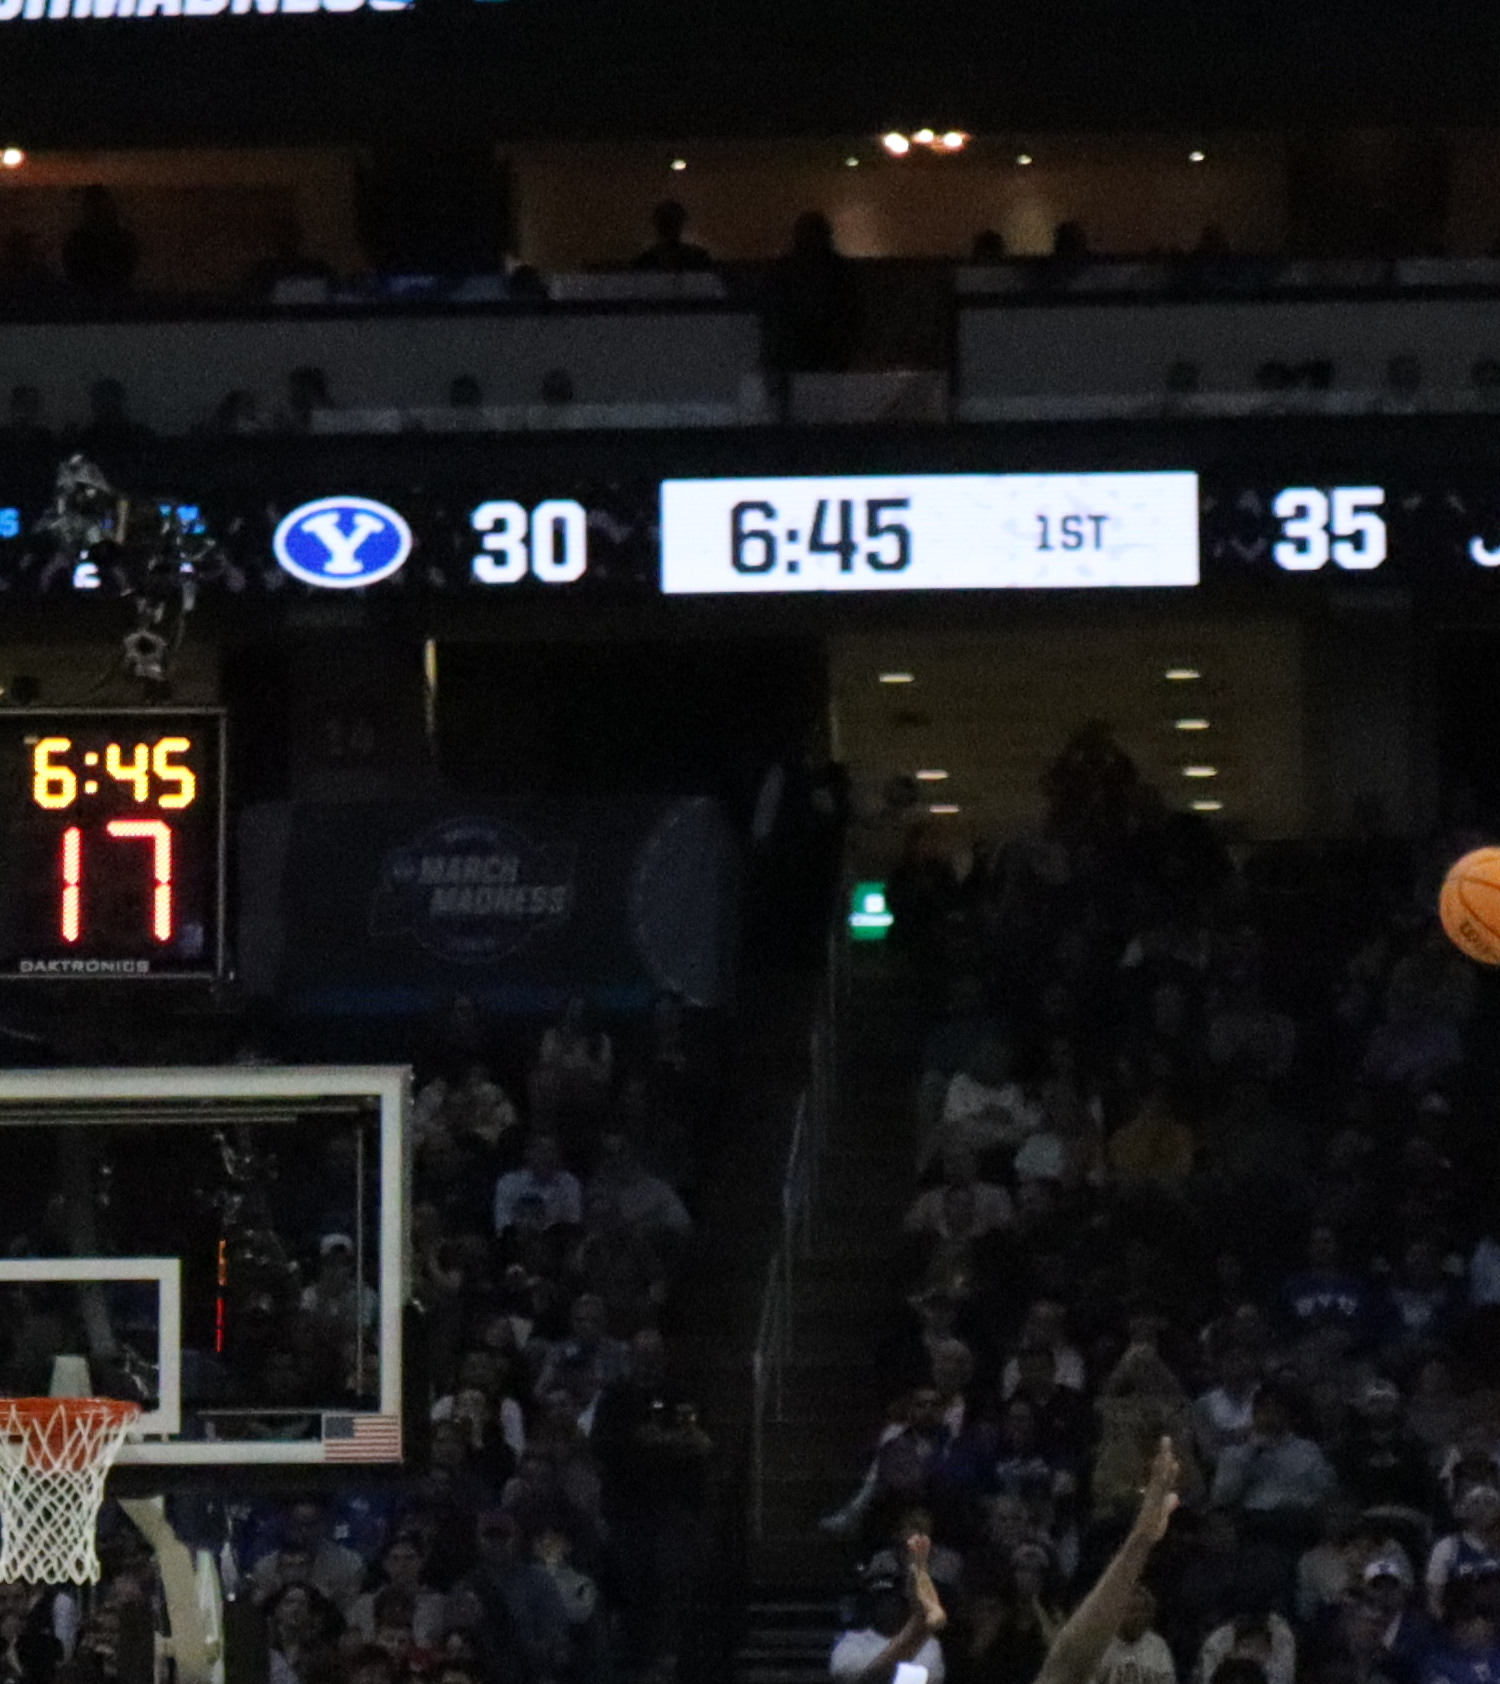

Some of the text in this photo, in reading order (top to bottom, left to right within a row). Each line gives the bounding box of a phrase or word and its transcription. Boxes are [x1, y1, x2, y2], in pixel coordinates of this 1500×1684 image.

[470, 499, 588, 585] 30
[730, 496, 1110, 575] 6:45 1ST
[1271, 484, 1387, 572] 35
[33, 737, 196, 810] 6:45
[62, 820, 171, 943] 17
[19, 959, 150, 973] DAKTRONICS
